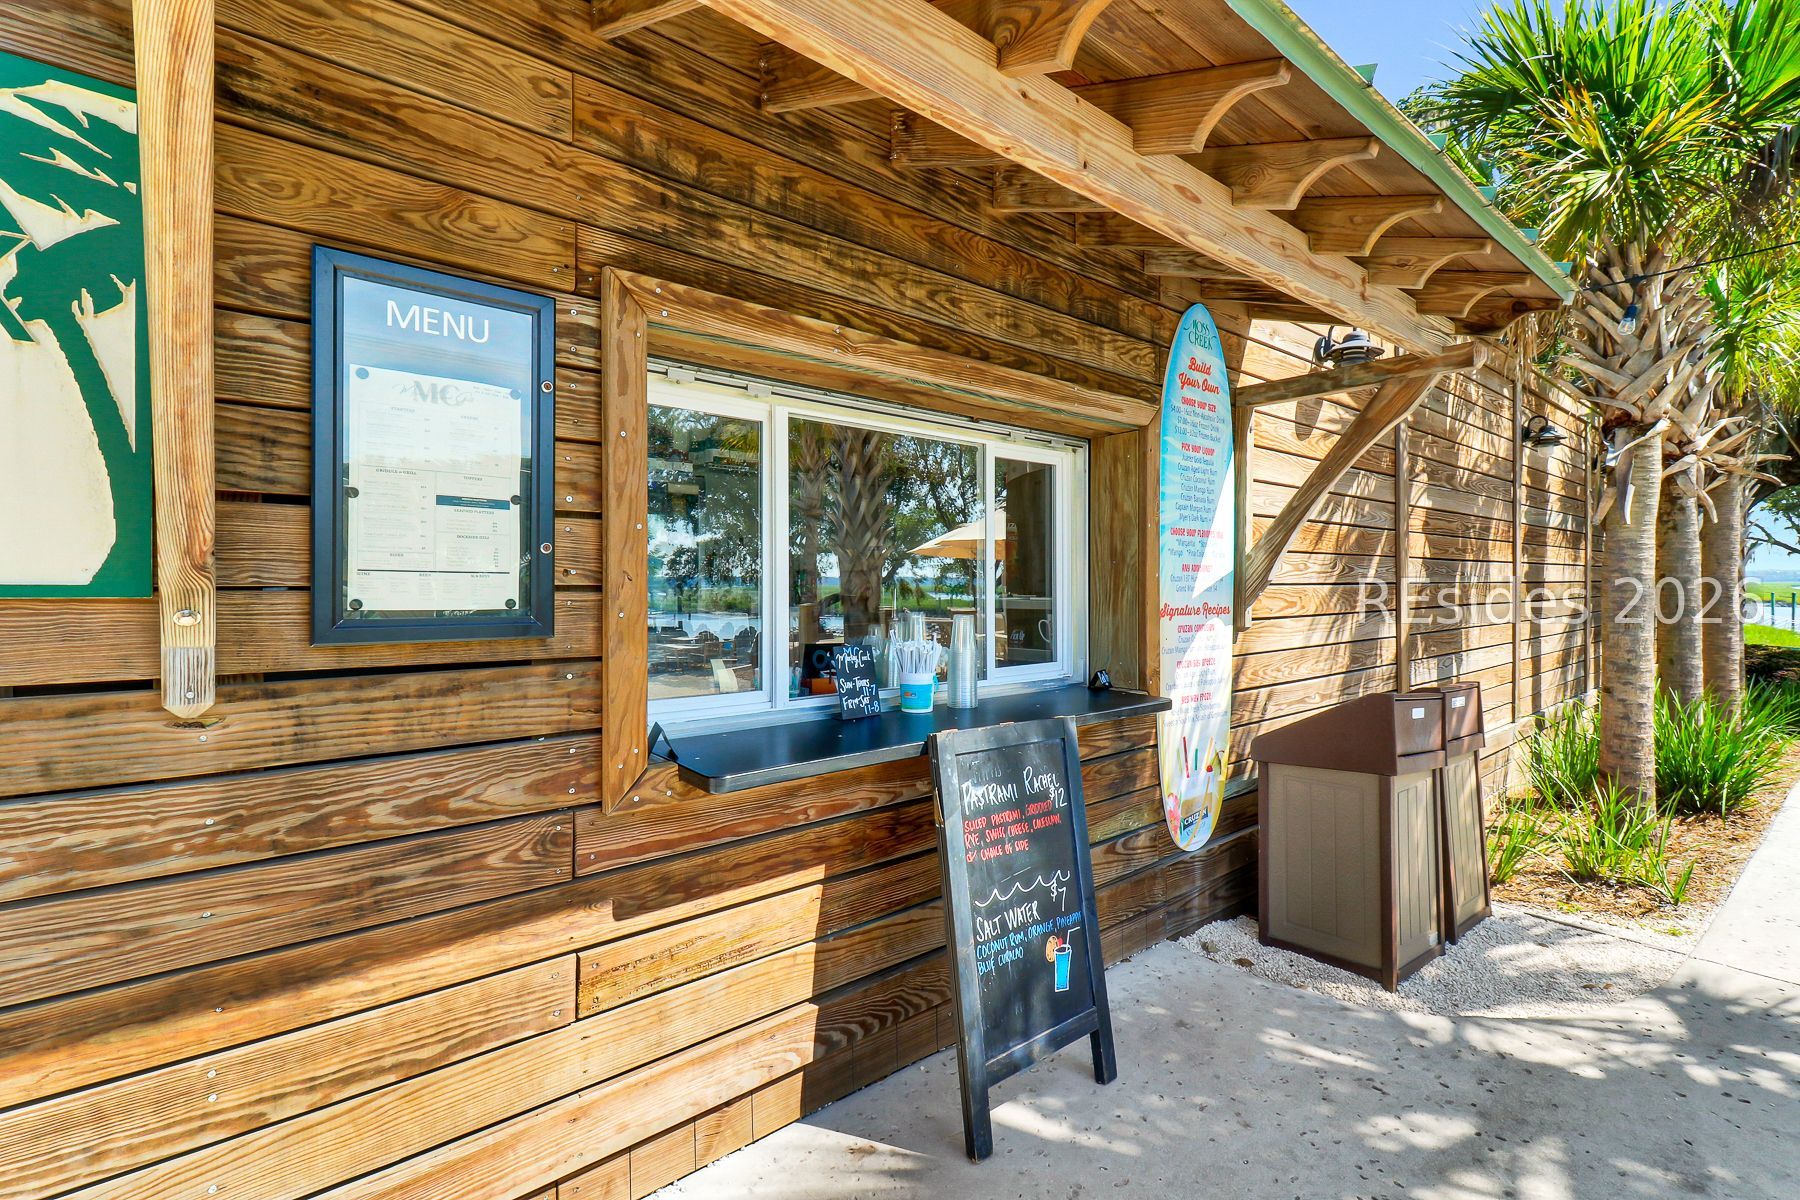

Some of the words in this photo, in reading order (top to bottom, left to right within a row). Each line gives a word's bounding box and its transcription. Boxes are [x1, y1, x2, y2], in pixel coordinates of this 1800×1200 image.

[386, 300, 489, 343] MENU
[1192, 320, 1210, 335] MOSS
[1189, 331, 1213, 350] CREEK
[1188, 356, 1212, 376] Build
[1178, 372, 1201, 390] Your
[1202, 378, 1220, 395] Own
[1159, 602, 1201, 621] Signature
[1202, 601, 1231, 619] Recipes
[862, 684, 876, 696] 11-7
[864, 700, 880, 715] 11-8
[961, 779, 1019, 815] PASTRAMI
[1023, 766, 1060, 795] RACHEL
[1048, 786, 1068, 809] $12
[964, 816, 987, 833] SLICED
[985, 826, 1006, 843] SWISS
[980, 843, 1003, 861] CHOICE
[1004, 843, 1013, 855] OF
[1014, 839, 1029, 851] SIDE
[1050, 879, 1067, 912] $7
[976, 914, 1002, 942] SALT
[1004, 900, 1041, 931] WATER
[976, 937, 1010, 960] COCONUT
[977, 960, 995, 976] BLUE
